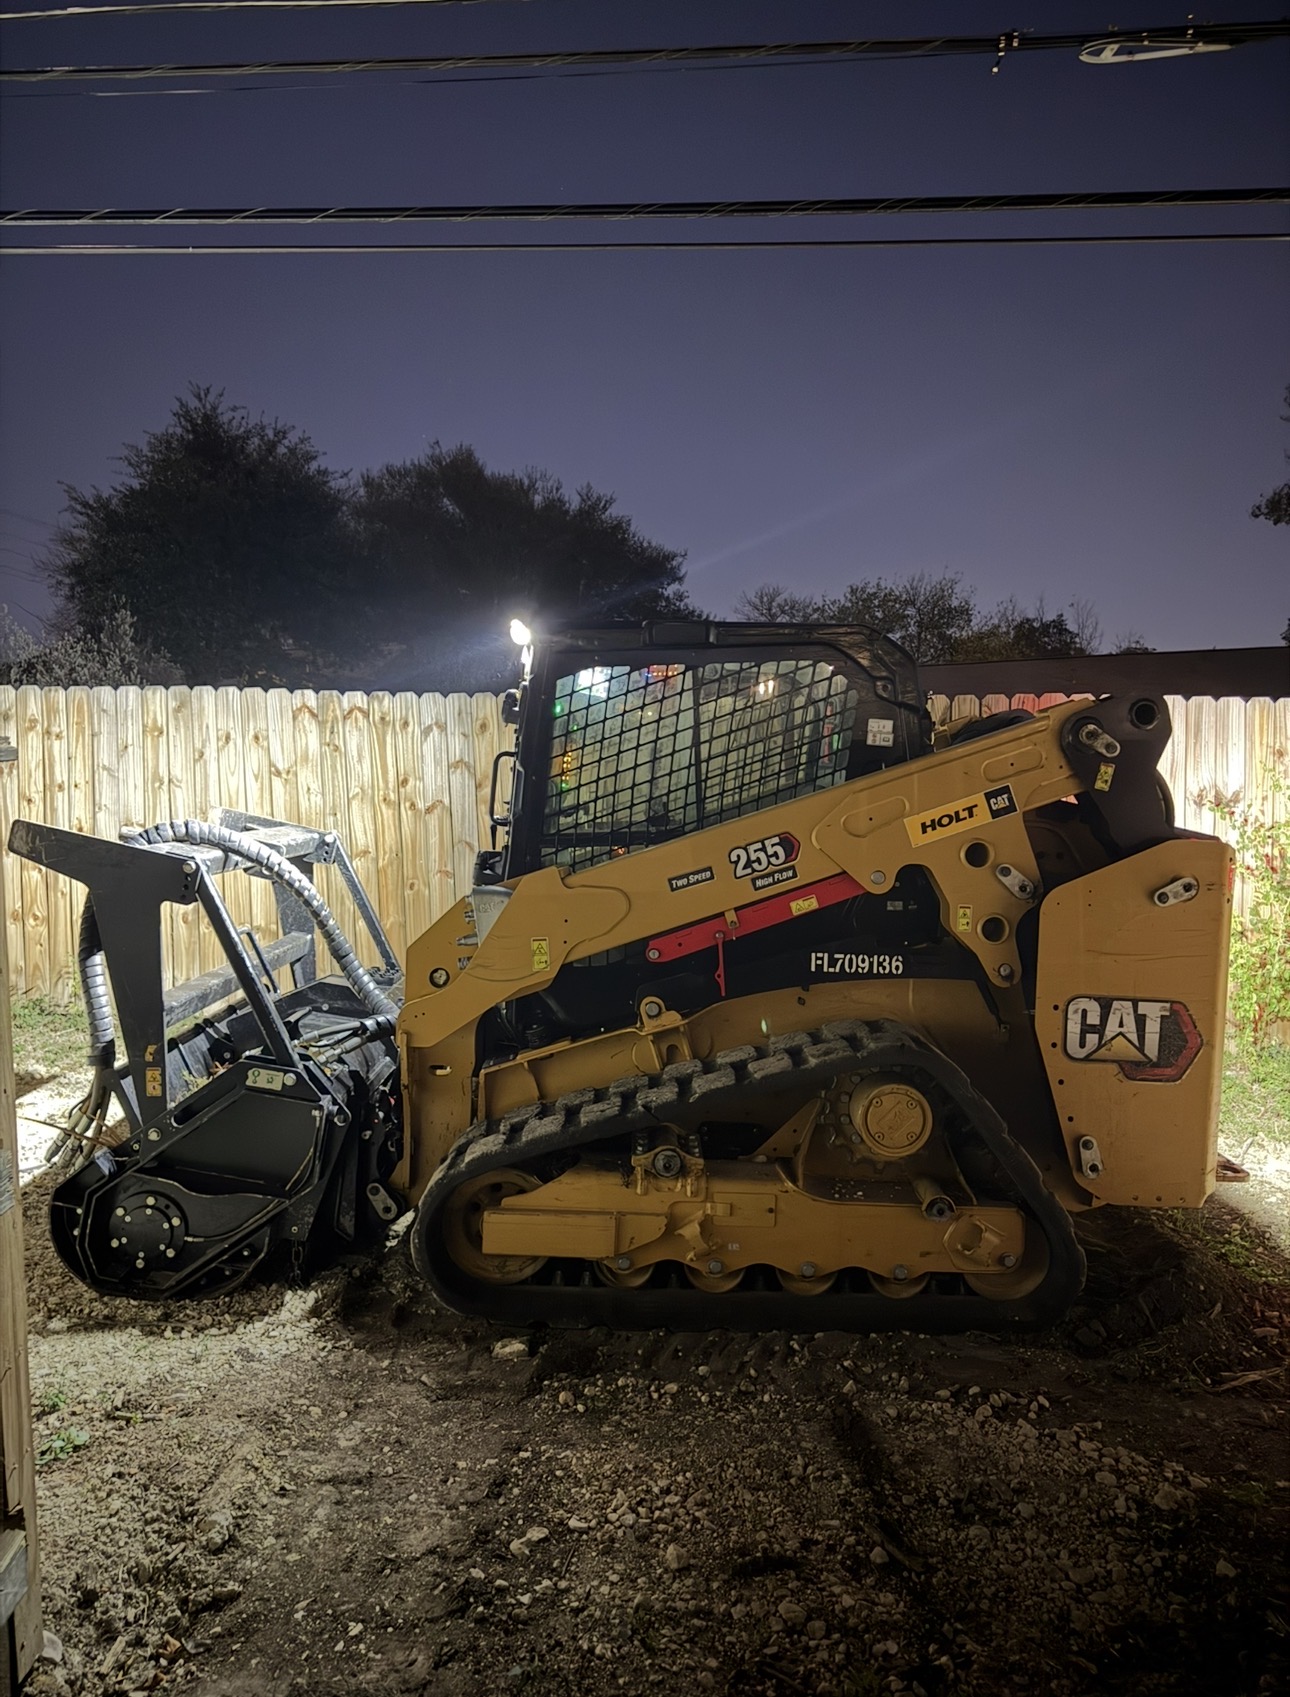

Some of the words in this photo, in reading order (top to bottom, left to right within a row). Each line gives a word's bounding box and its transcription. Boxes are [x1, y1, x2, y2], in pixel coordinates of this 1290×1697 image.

[921, 803, 978, 835] HOLT
[989, 793, 1010, 811] CAT
[730, 836, 786, 878] 255
[671, 879, 688, 889] TWO
[688, 871, 711, 884] SPEED
[755, 876, 773, 888] HIGH
[774, 869, 794, 882] FLOW
[810, 952, 904, 975] FL709136
[1066, 997, 1172, 1063] CAT
